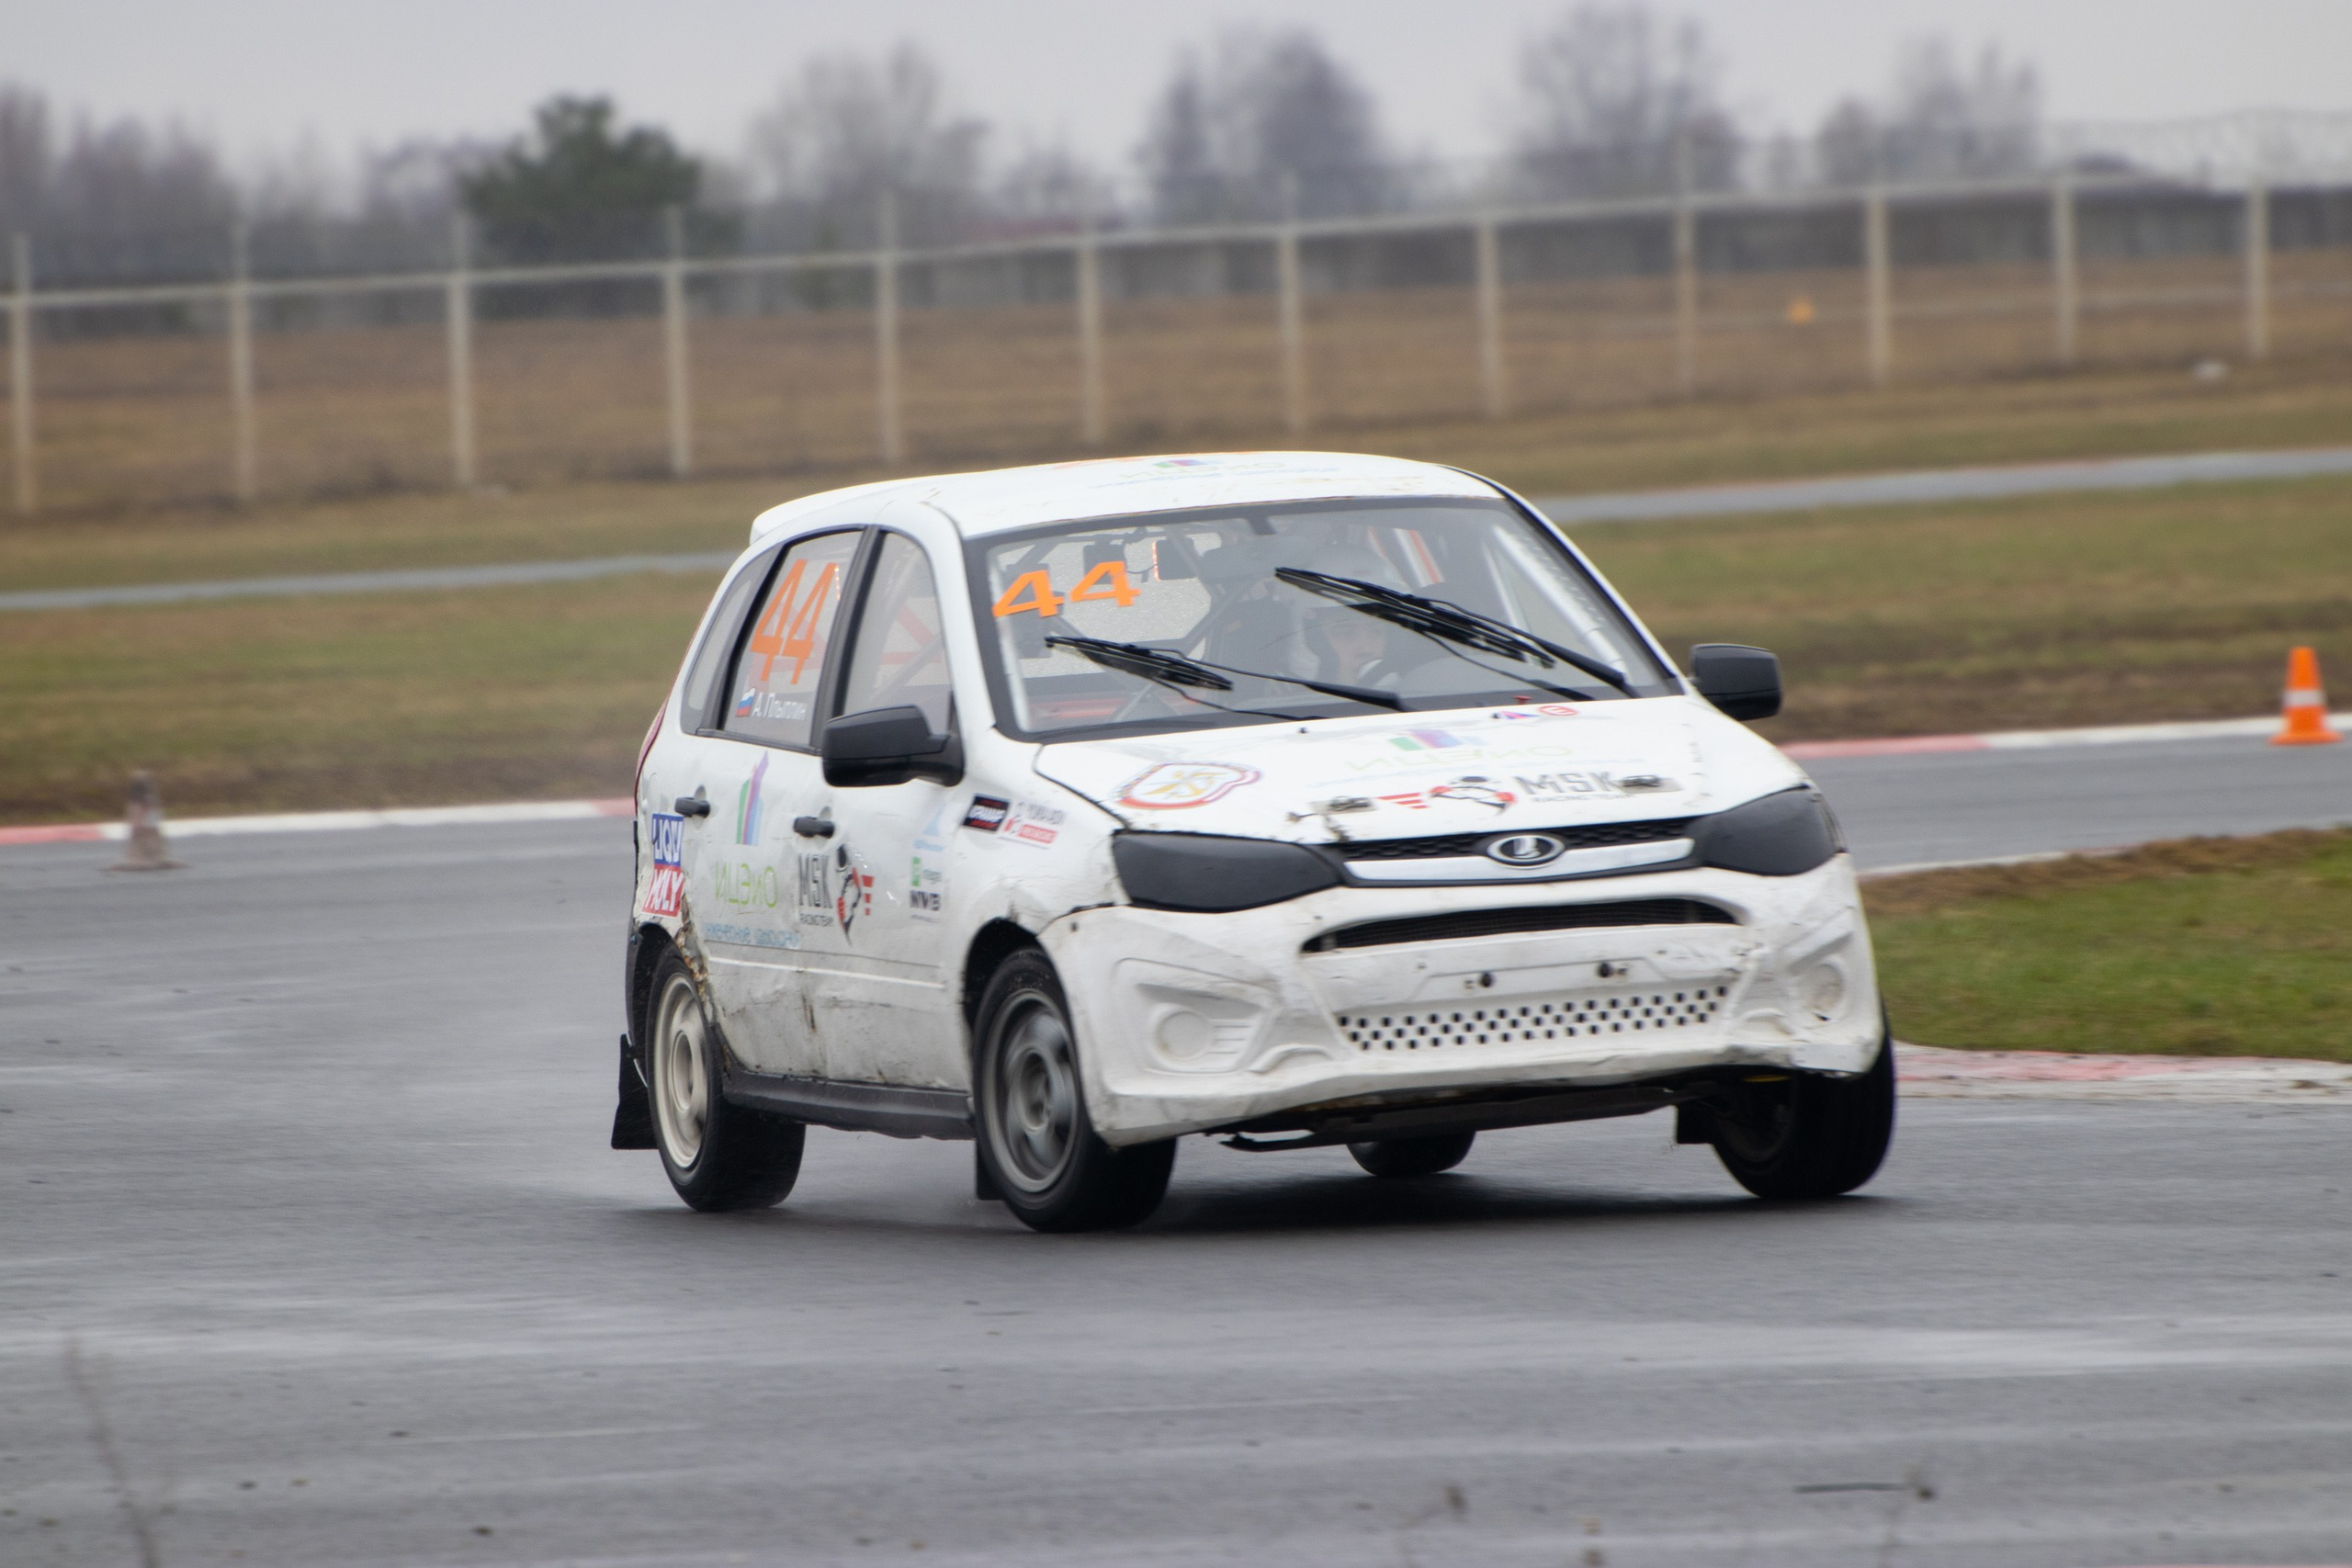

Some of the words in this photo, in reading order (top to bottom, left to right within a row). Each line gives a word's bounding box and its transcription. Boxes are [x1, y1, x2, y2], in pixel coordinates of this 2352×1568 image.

[992, 560, 1141, 617] 44
[750, 558, 839, 685] 44
[1512, 772, 1623, 795] MSK
[797, 852, 833, 908] MSK
